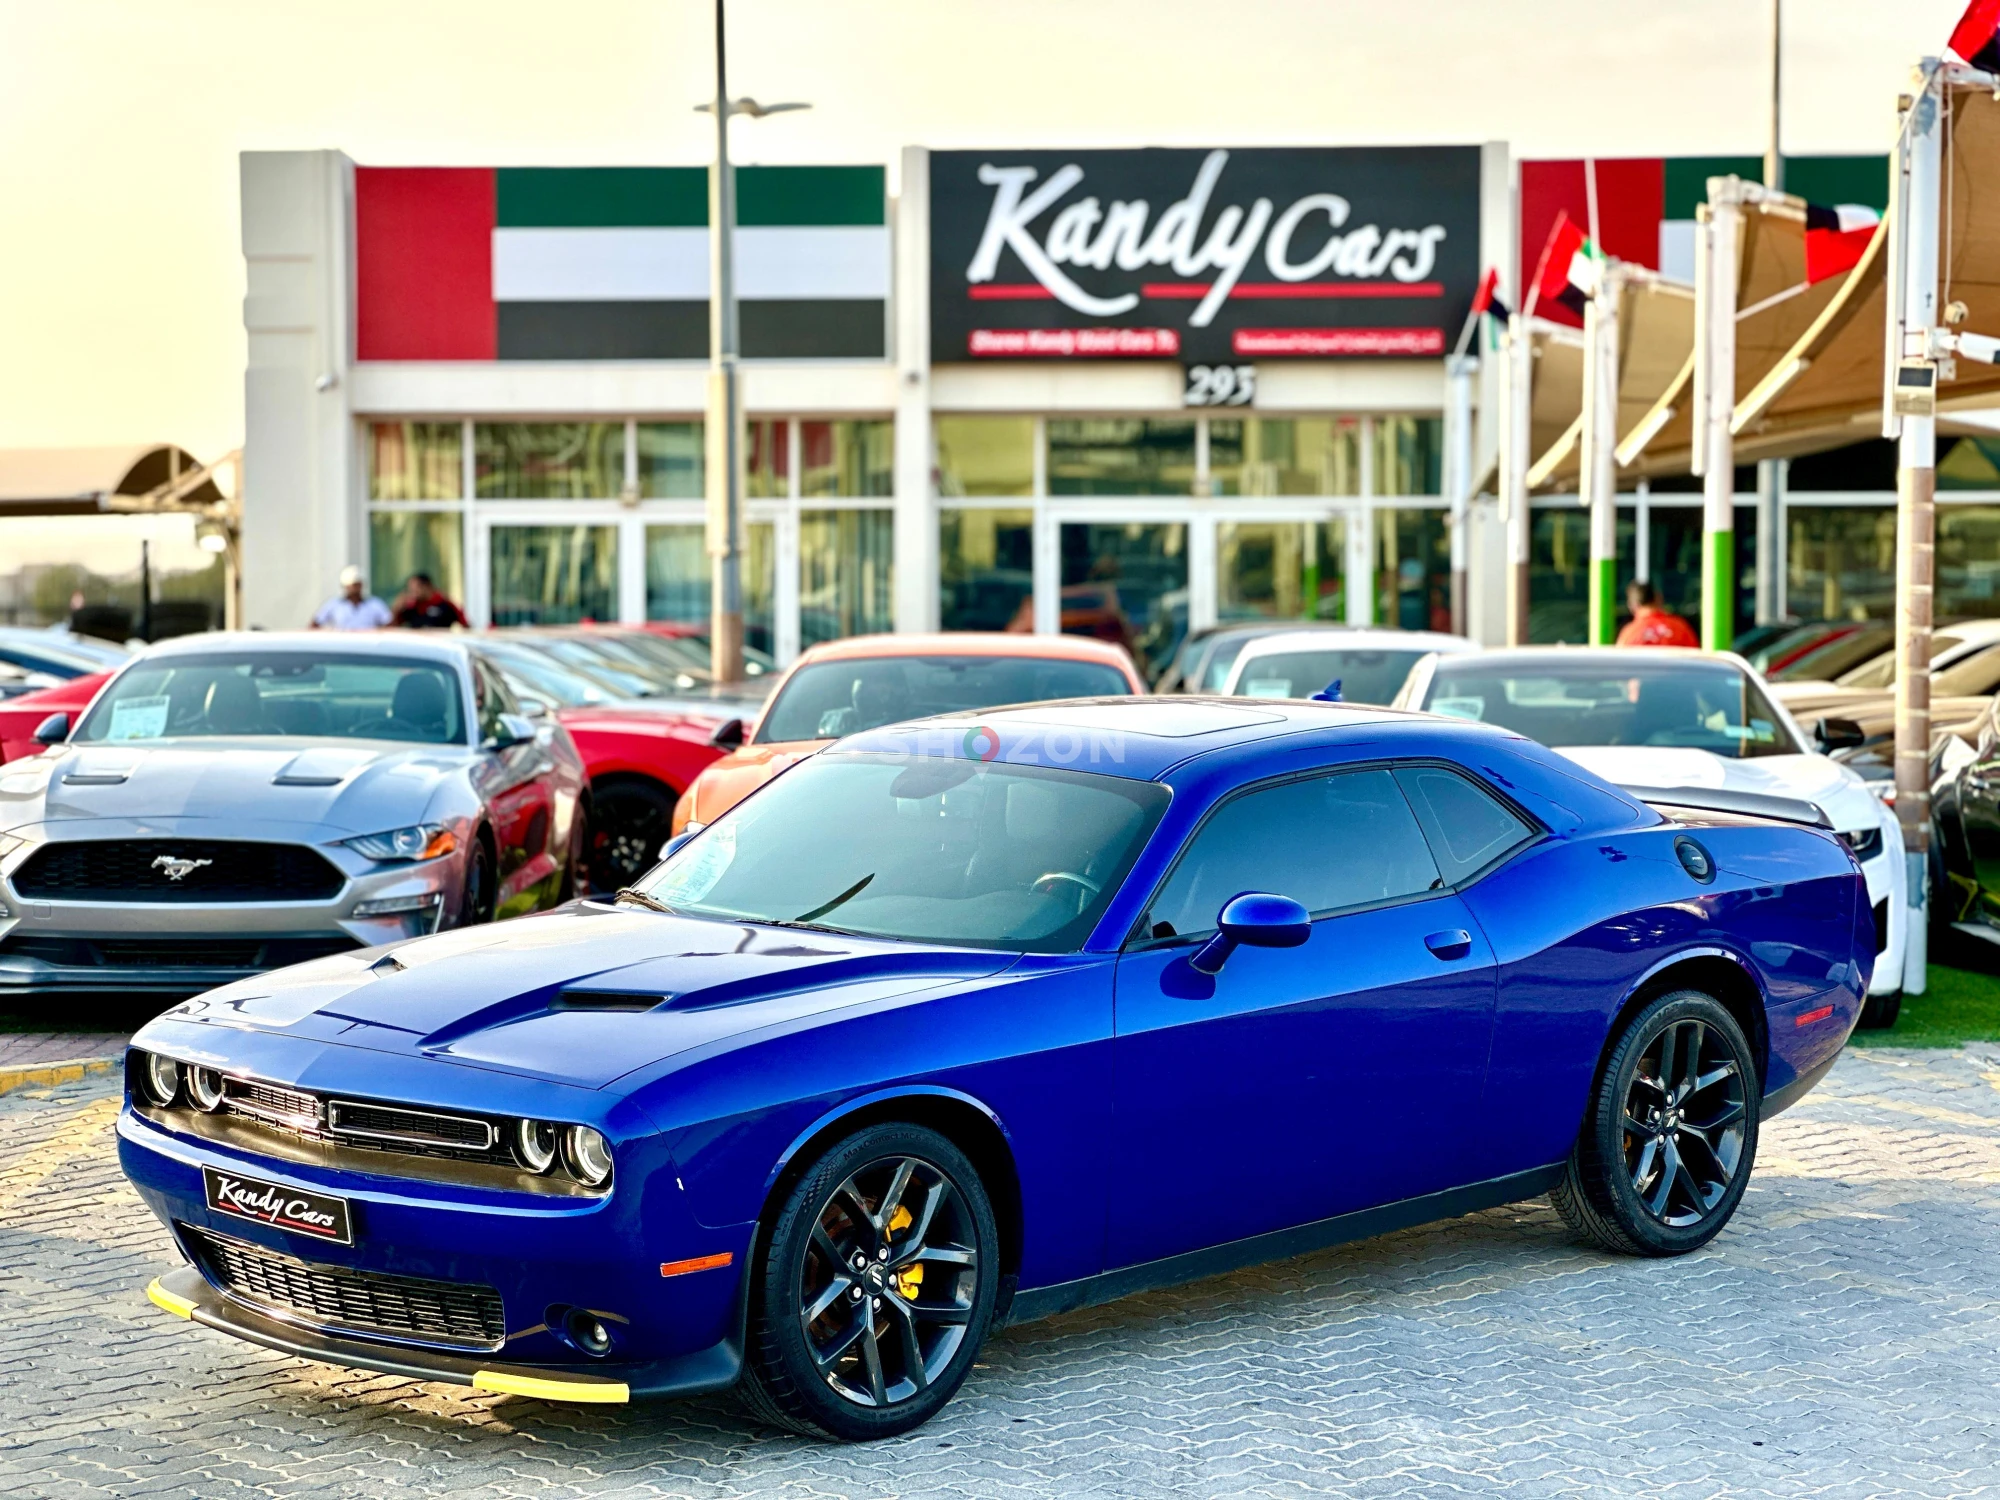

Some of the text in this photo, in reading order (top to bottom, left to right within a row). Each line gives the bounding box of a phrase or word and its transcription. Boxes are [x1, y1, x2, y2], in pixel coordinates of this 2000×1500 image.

[967, 150, 1447, 326] Kandy Cars
[1185, 365, 1254, 405] 295
[217, 1176, 335, 1226] Kandy Cars
